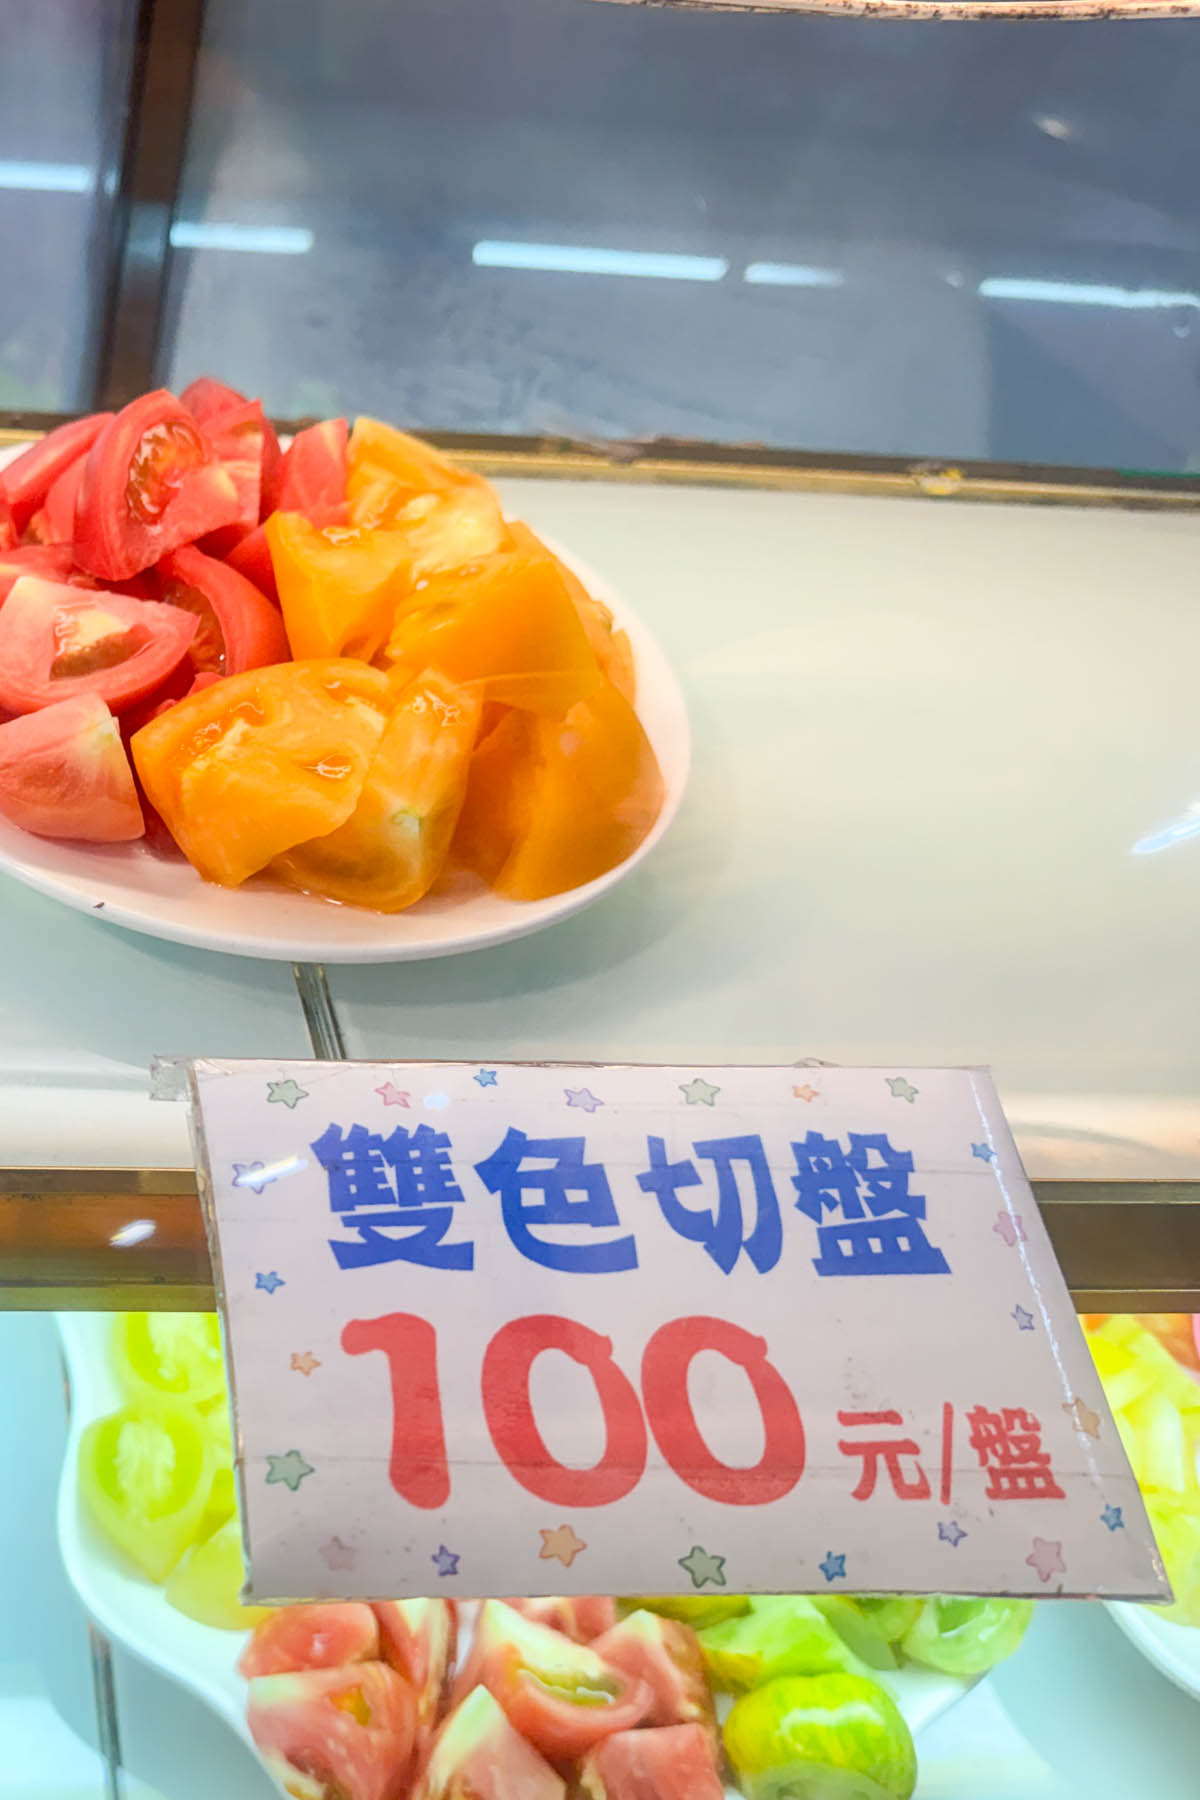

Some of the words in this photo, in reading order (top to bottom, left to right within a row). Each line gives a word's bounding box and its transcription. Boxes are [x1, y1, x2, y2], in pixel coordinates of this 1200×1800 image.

[309, 1124, 953, 1277] 雙色切盤
[340, 1312, 807, 1511] 100
[836, 1402, 1067, 1506] 元/盤
